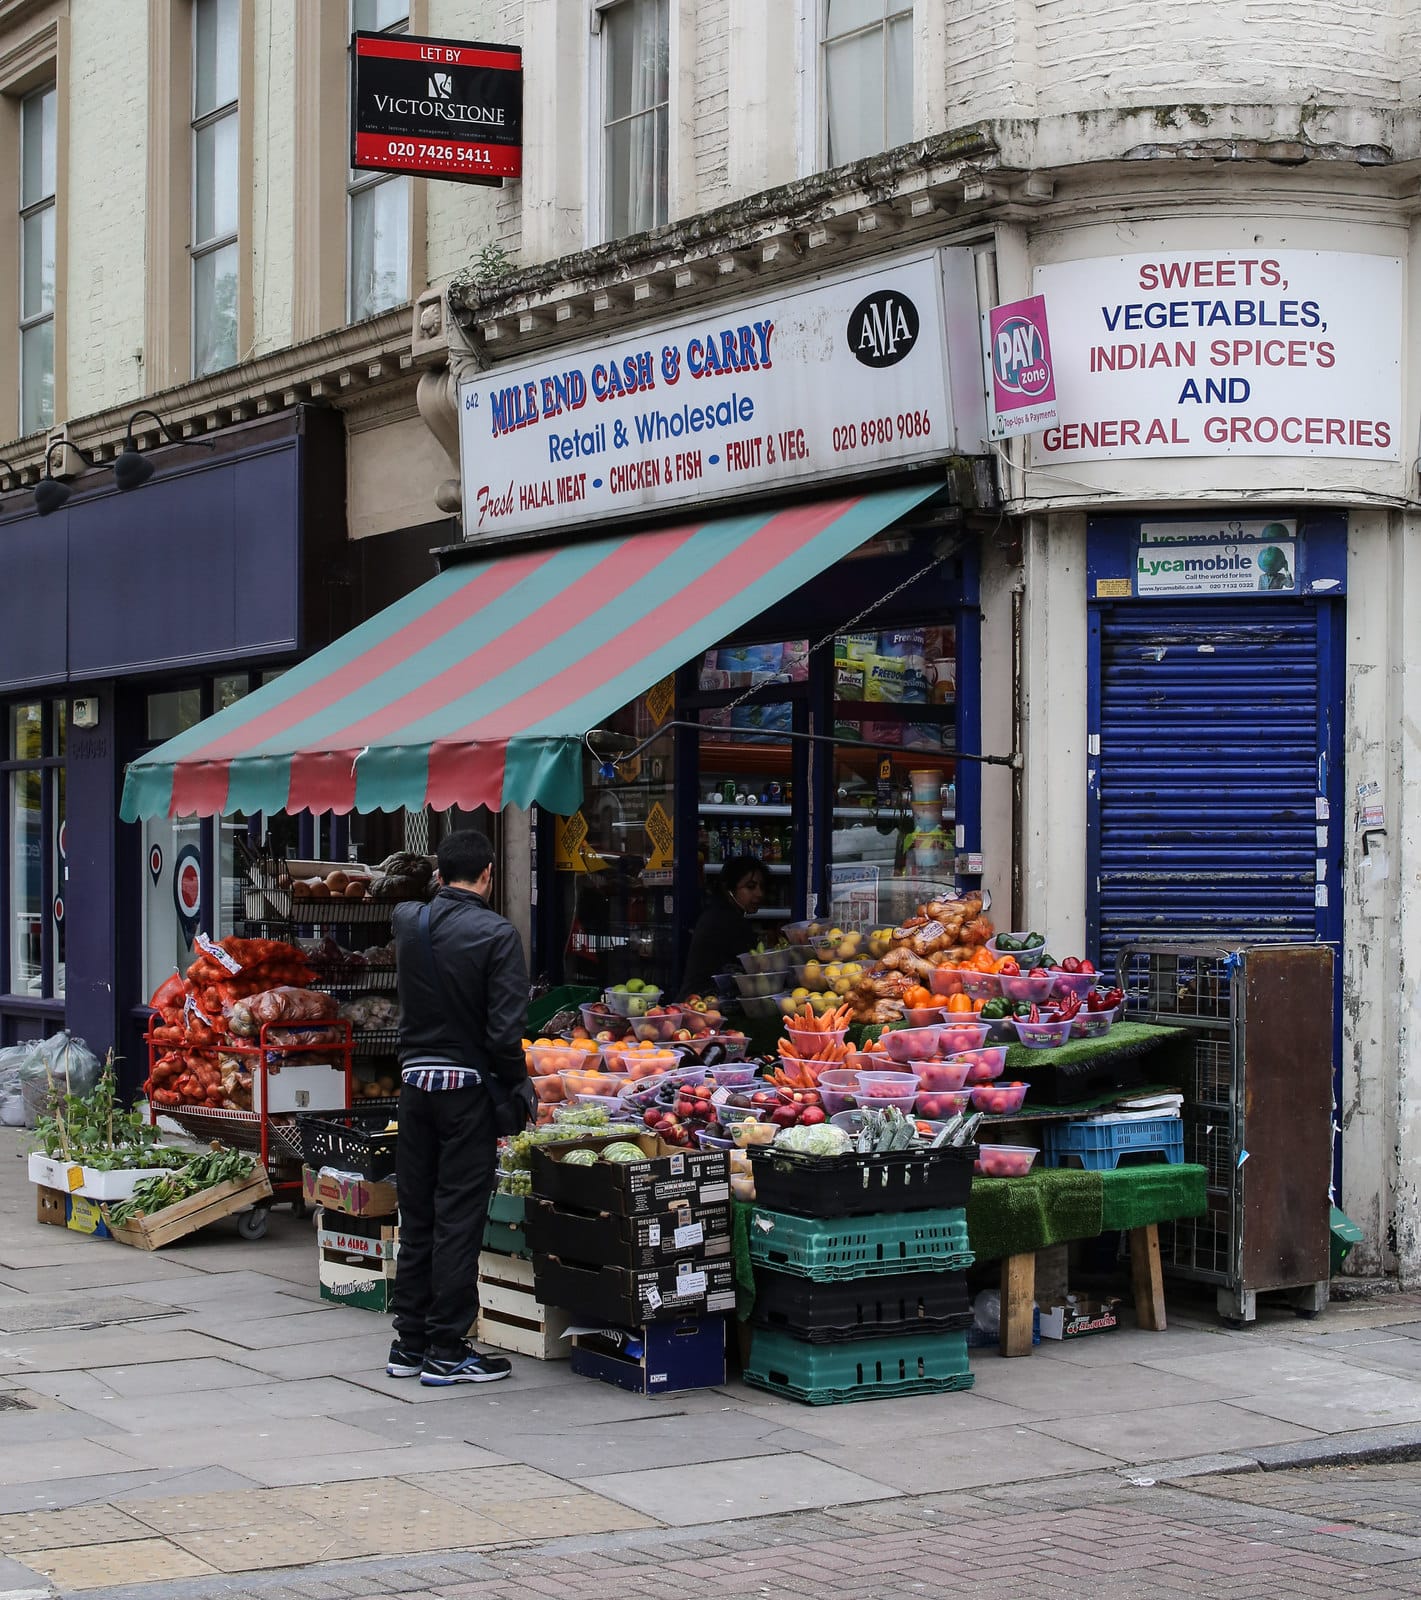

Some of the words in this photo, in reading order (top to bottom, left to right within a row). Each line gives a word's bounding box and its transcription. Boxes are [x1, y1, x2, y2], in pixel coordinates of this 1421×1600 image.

[420, 47, 441, 60] LET
[446, 49, 461, 62] BY
[374, 95, 505, 125] VICTORSTONE
[388, 142, 415, 157] 020
[418, 144, 453, 160] 7426
[456, 148, 491, 163] 5411
[1139, 259, 1289, 291] SWEETS,
[858, 299, 913, 358] AMA
[1101, 300, 1328, 333] VEGETABLES,
[997, 322, 1036, 381] PAY
[1089, 340, 1196, 373] INDIAN
[1209, 339, 1336, 368] SPICE'S
[490, 381, 539, 438] MILE
[541, 369, 587, 419] END
[591, 351, 655, 402] CASH
[661, 345, 680, 386] &
[686, 319, 775, 380] CARRY
[1021, 369, 1046, 385] zone
[1177, 377, 1251, 404] AND
[465, 393, 479, 411] 642
[1024, 414, 1030, 422] &
[1030, 409, 1057, 422] Payments
[549, 422, 606, 463] Retail
[613, 418, 629, 449] &
[634, 392, 754, 444] Wholesale
[832, 423, 857, 452] 020
[860, 416, 894, 447] 8980
[896, 409, 931, 440] 9086
[1042, 418, 1190, 452] GENERAL
[1203, 416, 1392, 449] GROCERIES
[726, 437, 762, 473] FRUIT
[766, 434, 776, 465] &
[779, 428, 810, 460] VEG.
[609, 459, 660, 495] CHICKEN
[664, 458, 673, 484] &
[675, 450, 703, 481] FISH
[476, 480, 515, 527] Fresh
[519, 480, 555, 512] HALAL
[557, 473, 587, 505] MEAT
[1138, 554, 1252, 576] Lycamobile
[1209, 572, 1229, 580] world
[872, 665, 904, 680] FREEDO
